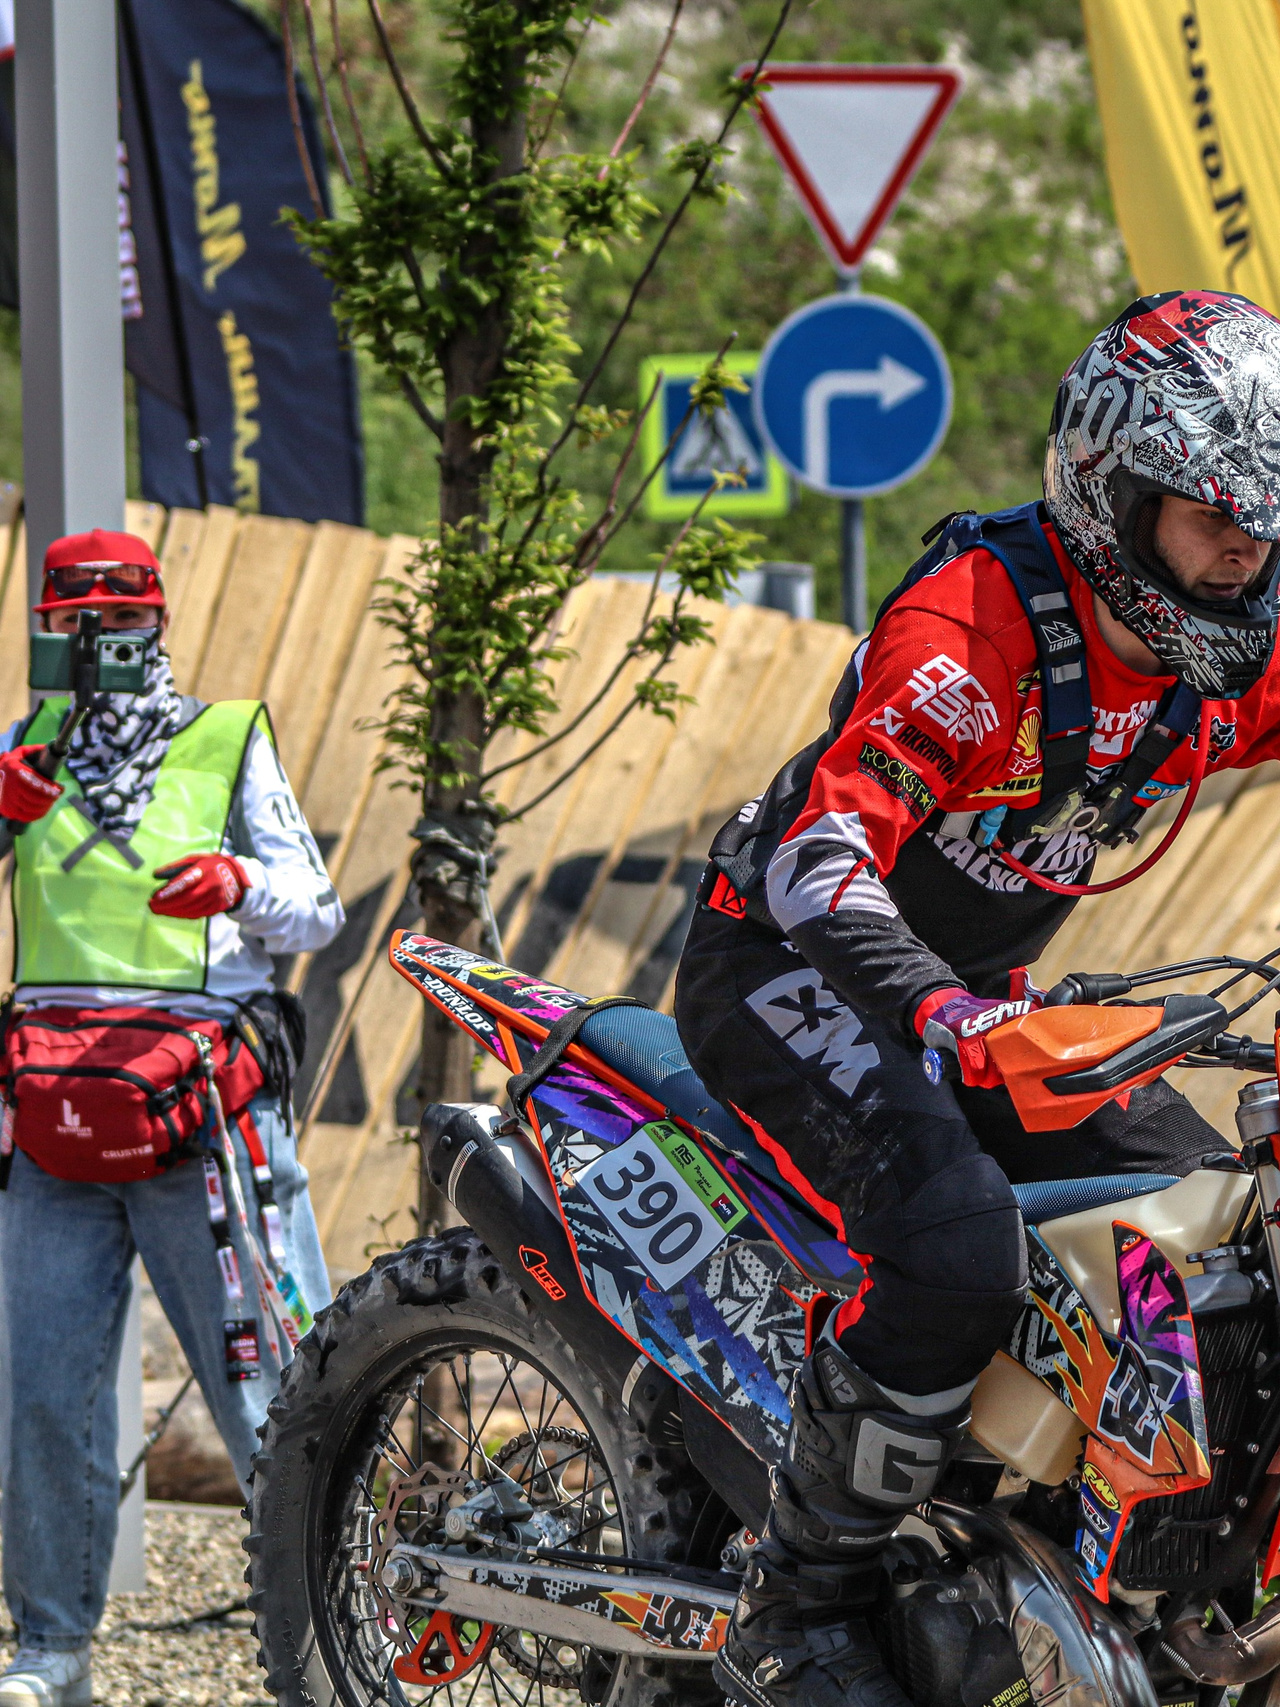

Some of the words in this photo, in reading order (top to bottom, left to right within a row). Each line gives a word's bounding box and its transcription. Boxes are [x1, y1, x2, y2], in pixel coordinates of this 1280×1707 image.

[1082, 530, 1094, 549] 390
[424, 976, 494, 1033] DUNLOP
[593, 1150, 703, 1265] 390
[717, 1198, 732, 1216] LAVR
[231, 1337, 256, 1348] MEDIA
[1084, 1465, 1119, 1507] FMF
[992, 1678, 1028, 1707] ENDURO
